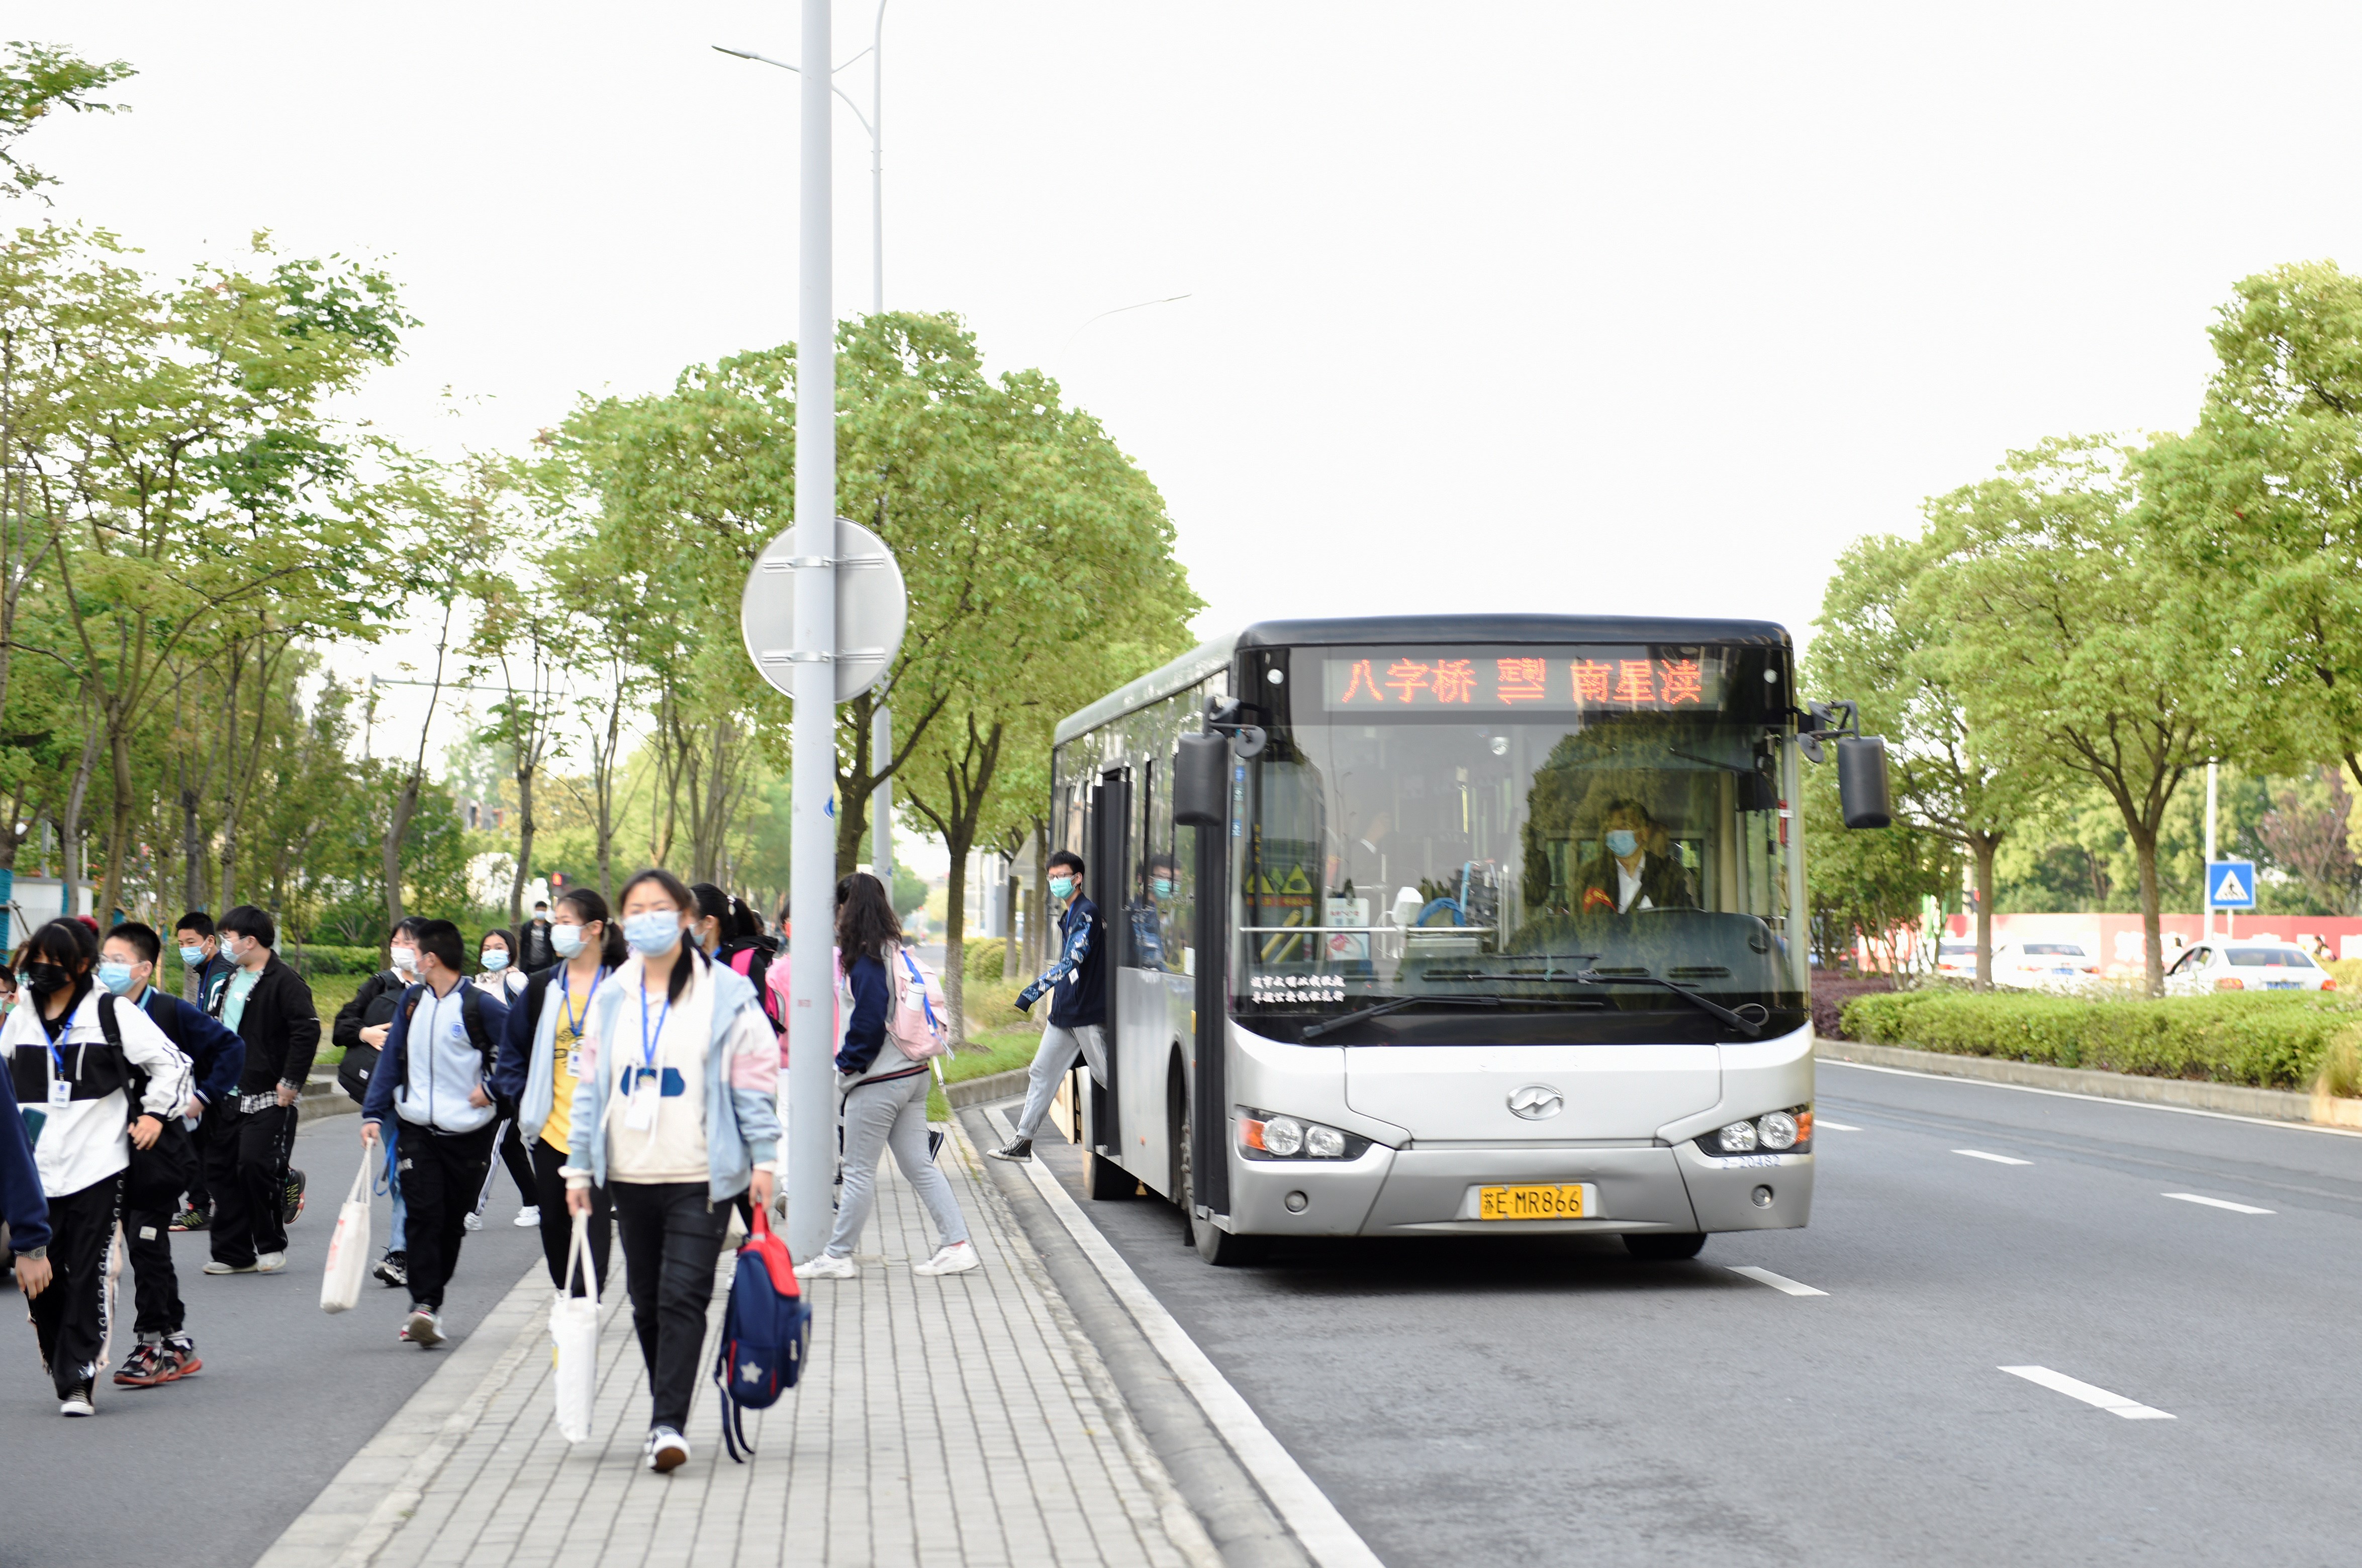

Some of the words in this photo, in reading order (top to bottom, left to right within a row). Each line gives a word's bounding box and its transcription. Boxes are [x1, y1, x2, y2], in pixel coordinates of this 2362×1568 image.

[1343, 658, 1477, 703] 八字桥
[1571, 659, 1702, 705] 南星渎
